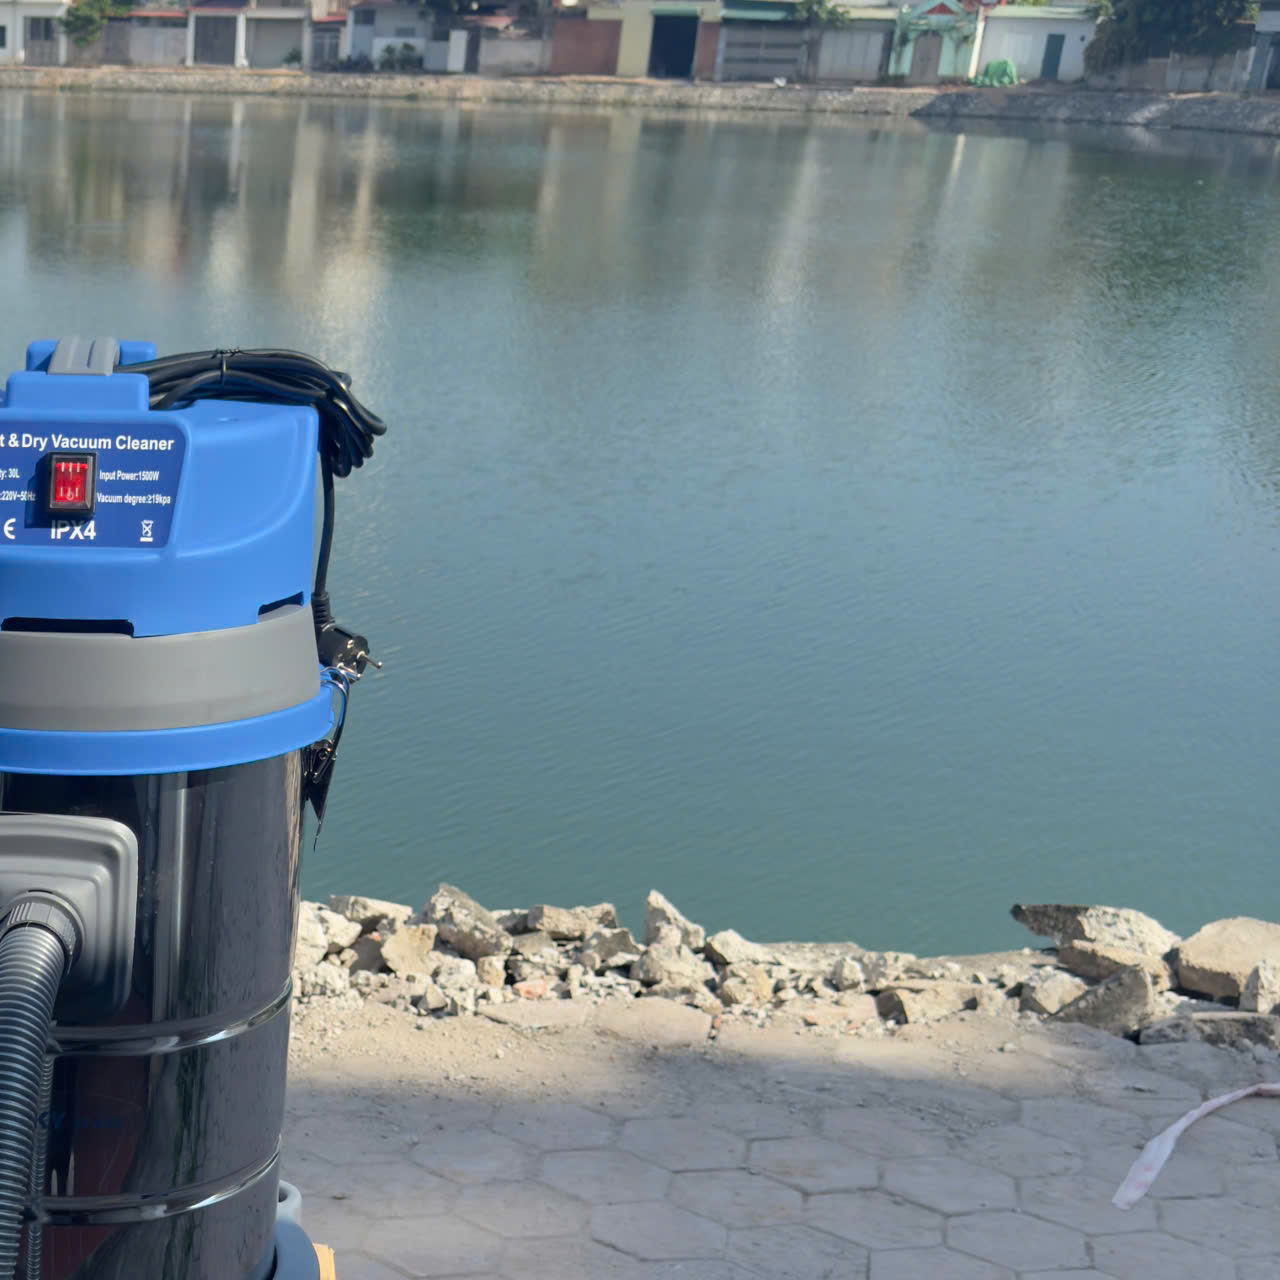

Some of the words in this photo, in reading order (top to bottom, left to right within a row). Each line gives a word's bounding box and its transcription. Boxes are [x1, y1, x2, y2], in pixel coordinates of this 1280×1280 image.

[8, 433, 19, 448] &
[21, 434, 48, 451] Dry
[51, 434, 112, 449] Vacuum
[115, 435, 174, 450] Cleaner
[8, 468, 20, 478] 30L
[99, 469, 116, 482] Input
[96, 492, 123, 503] Vacuum
[50, 519, 96, 540] IPX4
